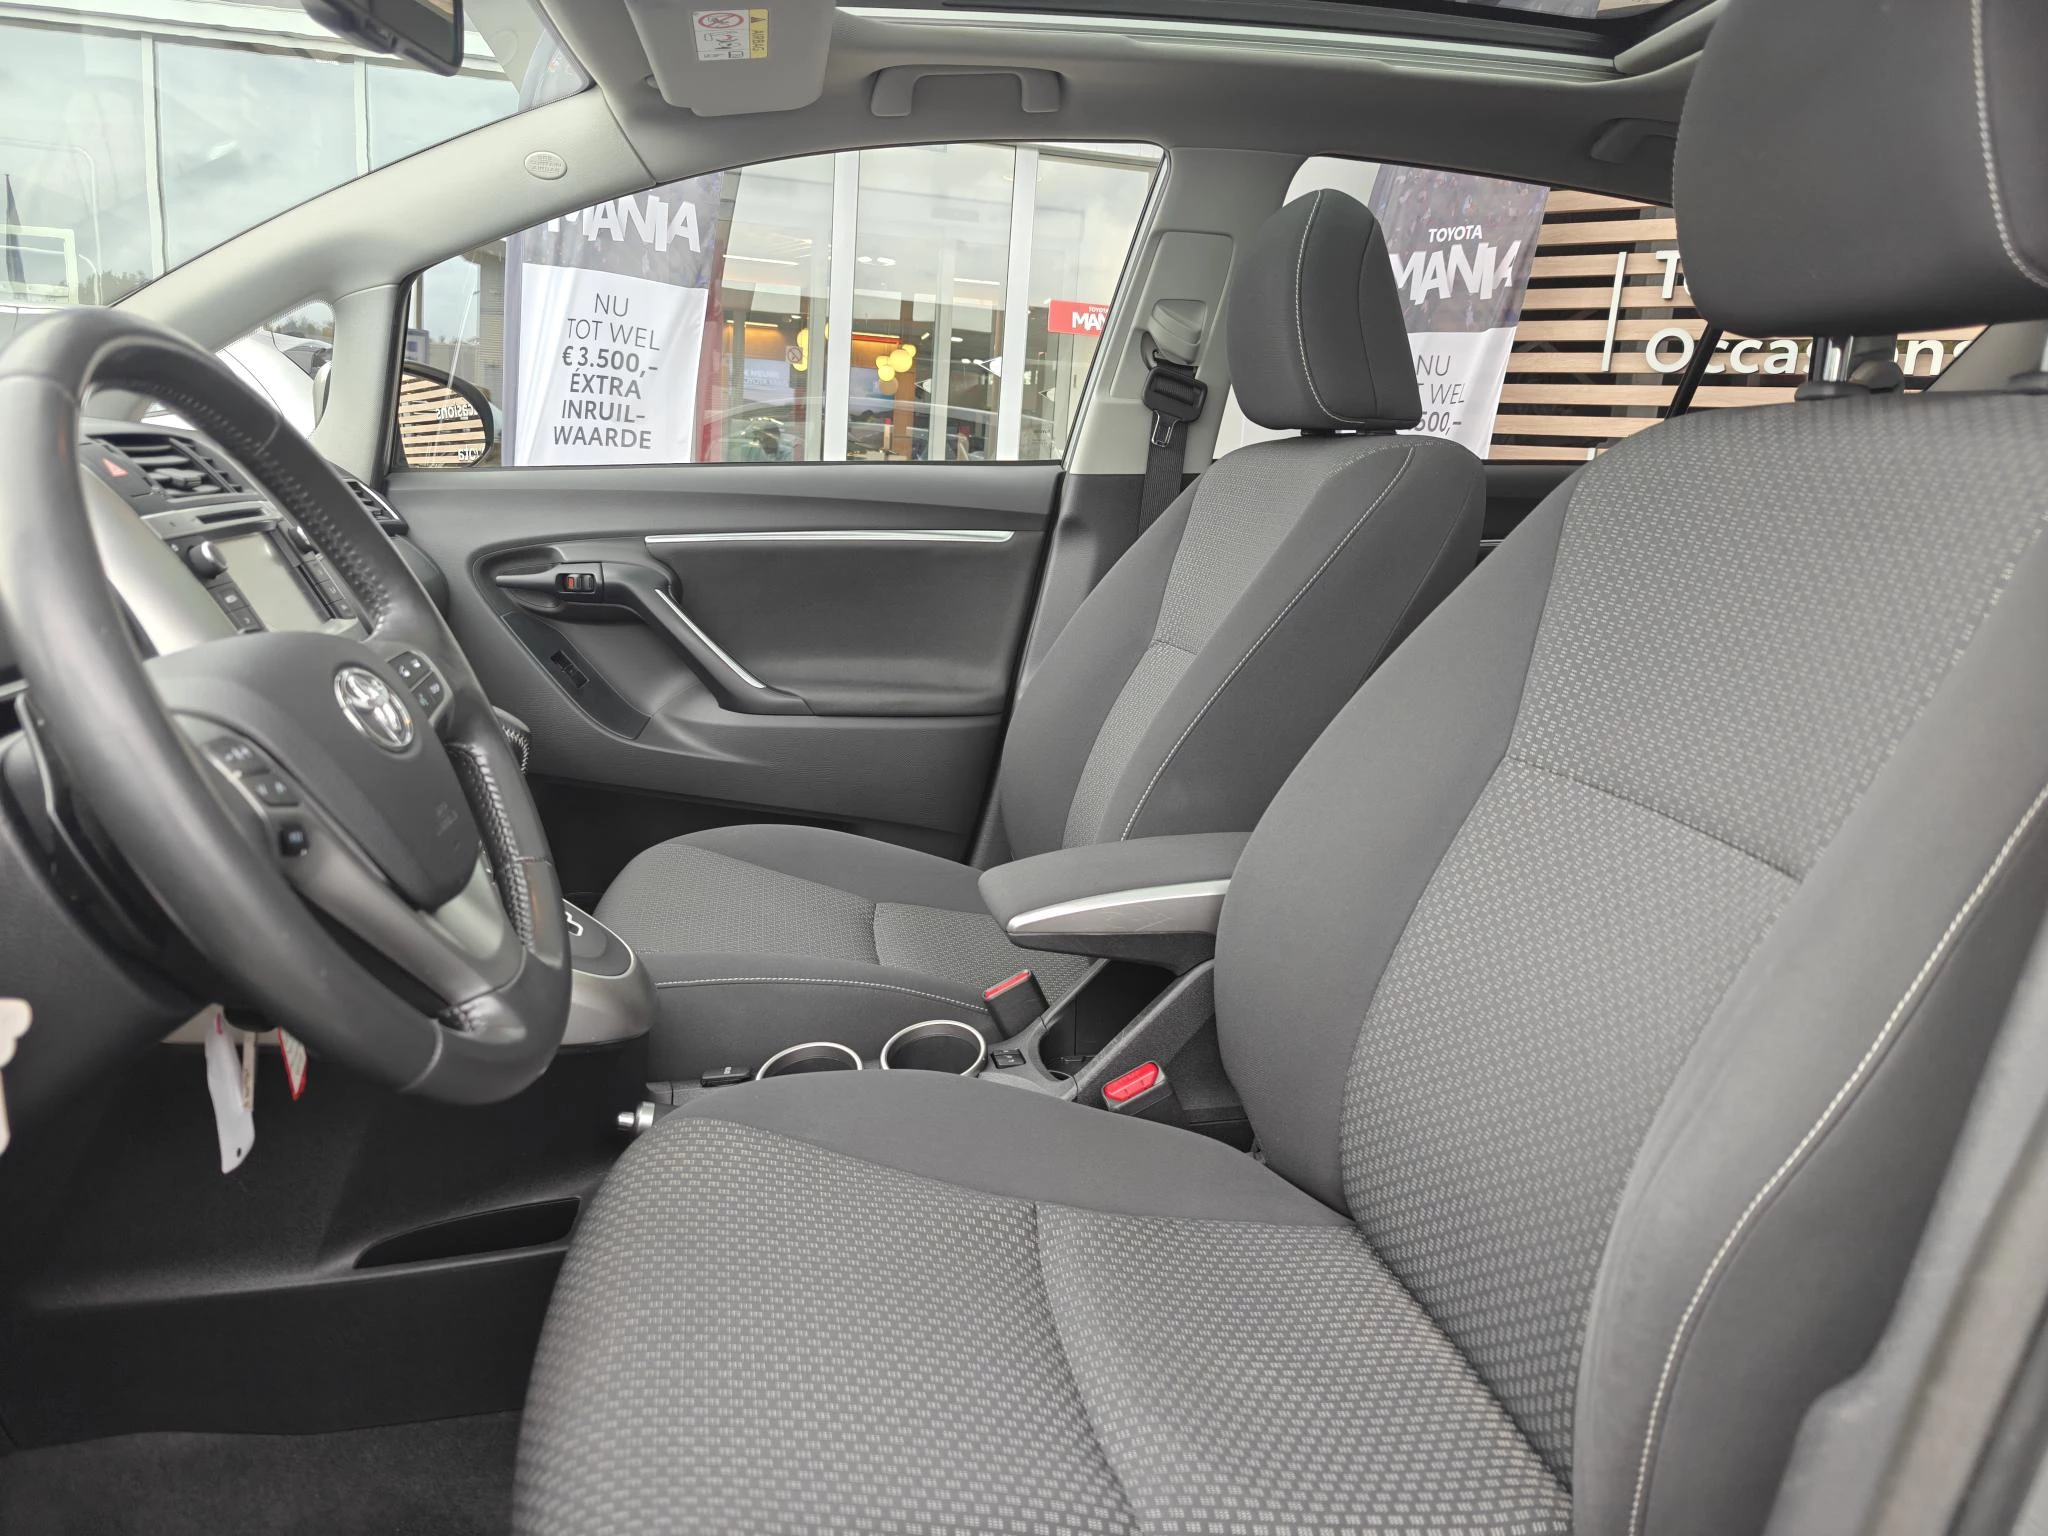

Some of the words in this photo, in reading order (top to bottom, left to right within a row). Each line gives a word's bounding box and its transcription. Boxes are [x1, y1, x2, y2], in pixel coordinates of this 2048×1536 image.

[1428, 224, 1483, 243] TOYOTA
[594, 292, 629, 317] NU
[1072, 311, 1107, 331] MAN
[567, 318, 603, 341] TOT
[609, 322, 661, 351] WEL
[1416, 354, 1451, 377] NU
[1430, 383, 1465, 405] WEL
[561, 399, 647, 423] INRUIL-
[554, 425, 652, 450] WAARDE
